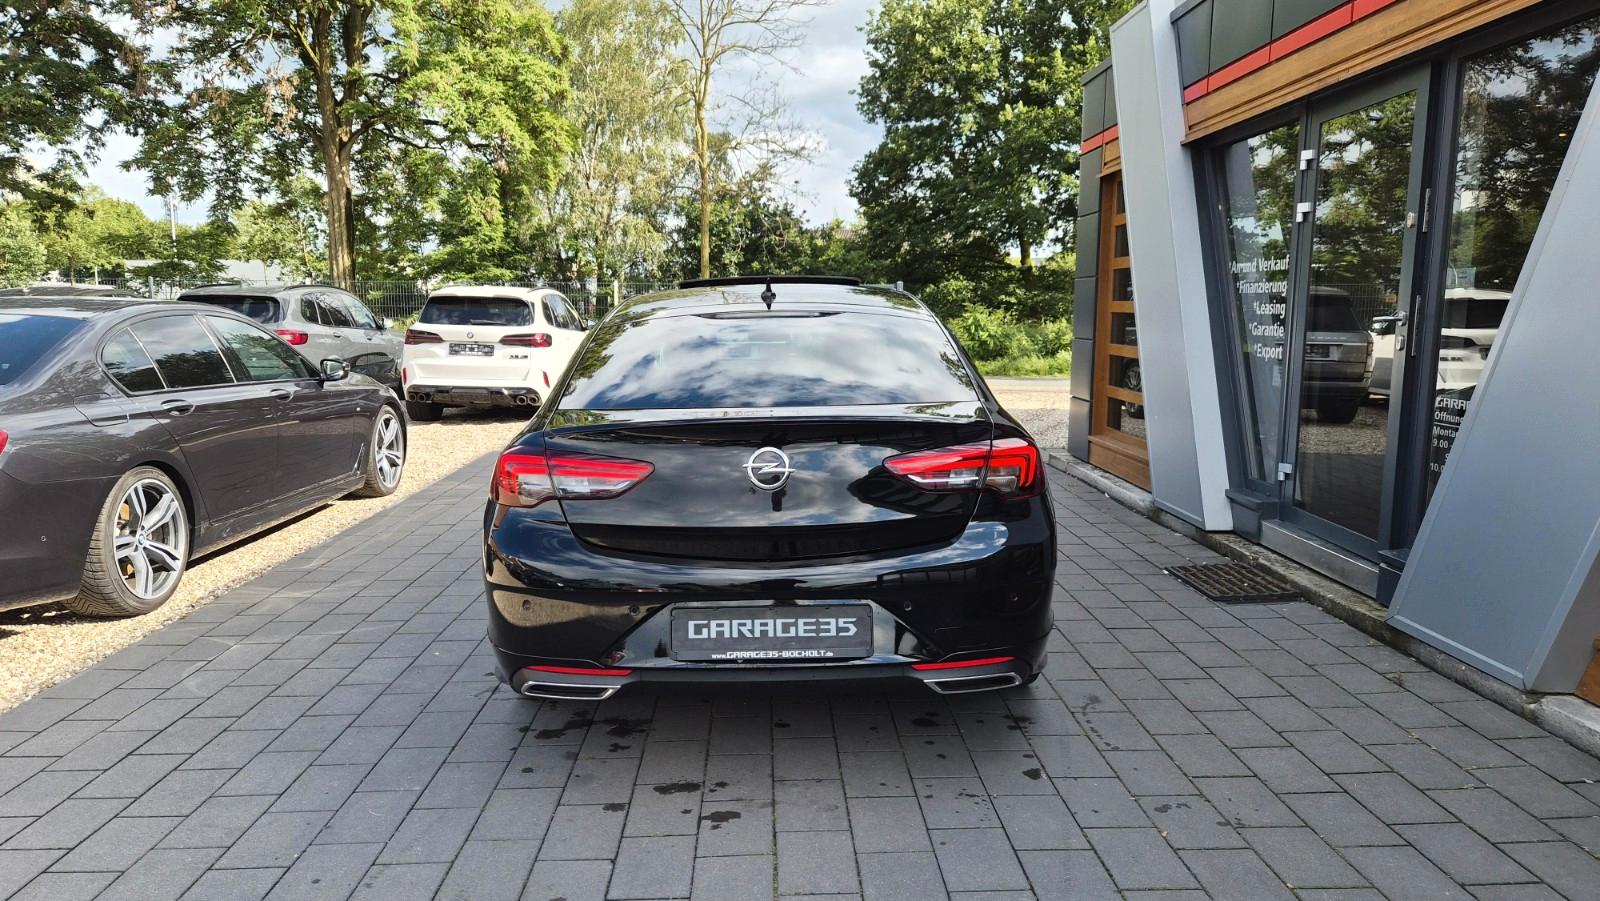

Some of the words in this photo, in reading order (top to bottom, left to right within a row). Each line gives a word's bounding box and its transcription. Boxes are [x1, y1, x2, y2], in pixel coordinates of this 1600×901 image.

[1259, 254, 1290, 272] Verkauf
[1435, 396, 1469, 410] GARA
[687, 617, 858, 639] GARAGE35
[711, 650, 834, 659] www.GARAGE35-BOCHOLT.de
